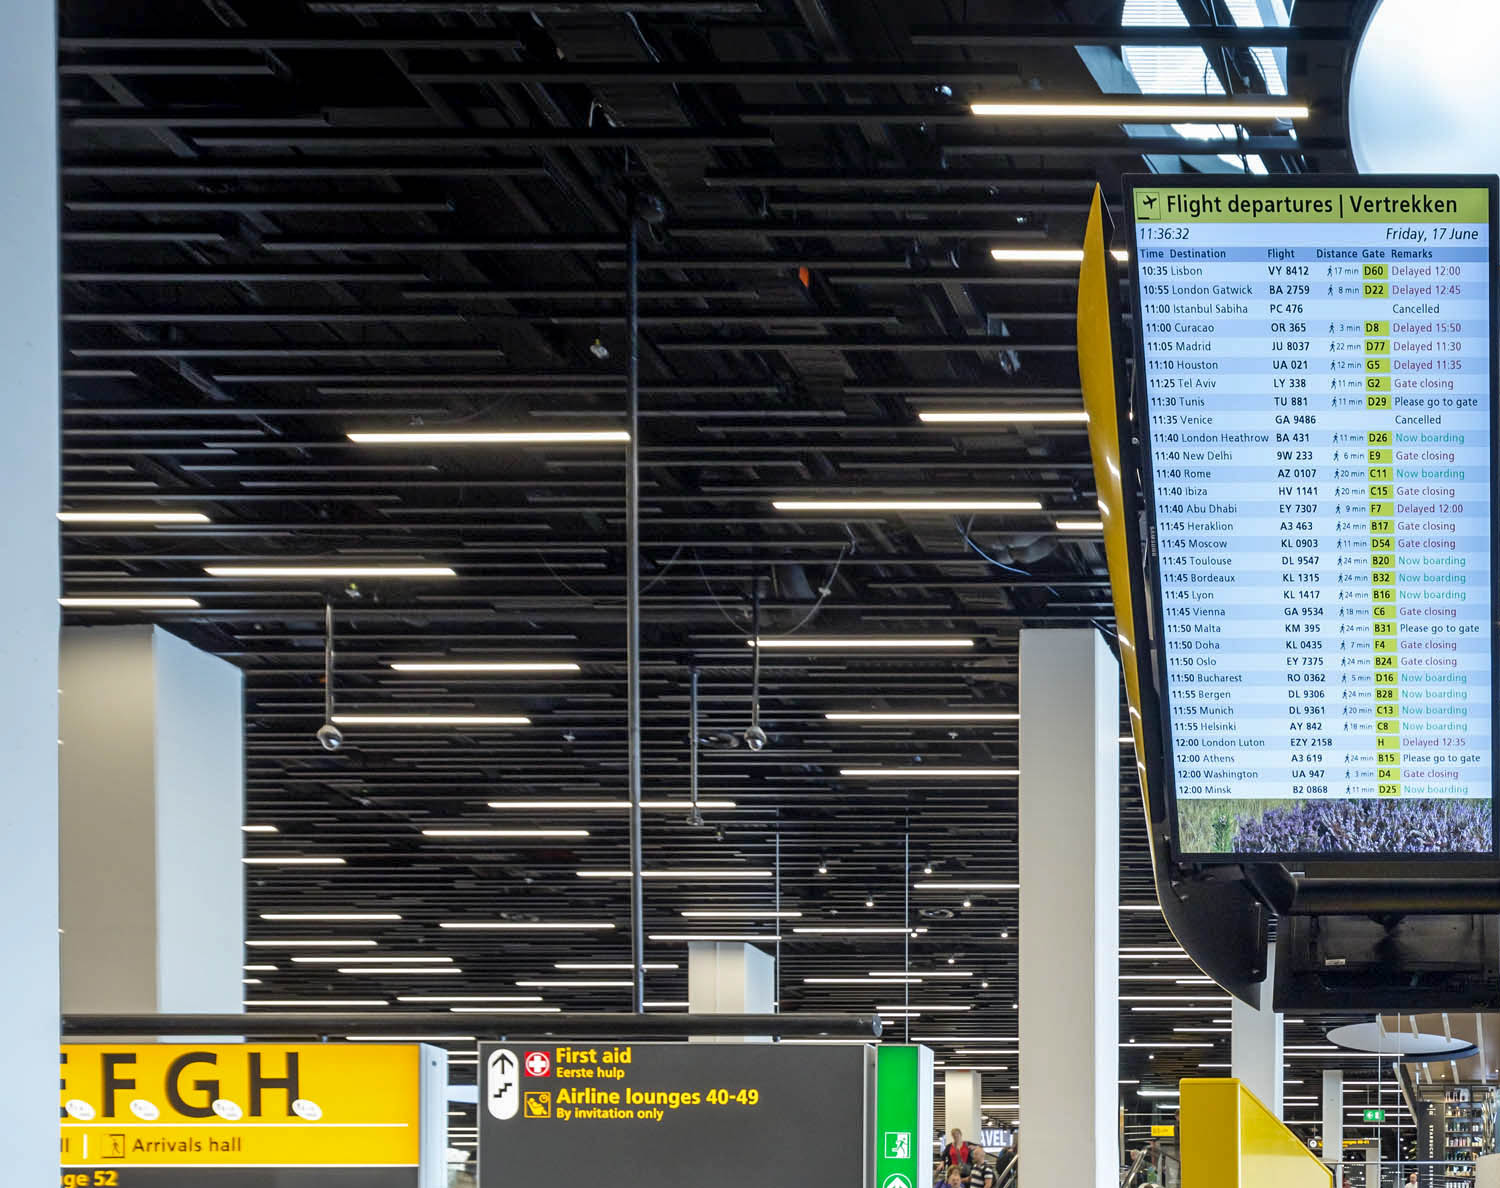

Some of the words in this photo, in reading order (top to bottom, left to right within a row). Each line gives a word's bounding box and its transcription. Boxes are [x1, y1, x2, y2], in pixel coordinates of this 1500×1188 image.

[1168, 194, 1221, 217] Flight
[1228, 194, 1332, 217] departures
[1350, 195, 1456, 212] Vertrekken
[1141, 228, 1189, 239] 11:36:32
[1387, 228, 1426, 242] Friday,
[1433, 228, 1446, 239] 17
[1449, 228, 1478, 239] June
[1140, 249, 1164, 258] Time
[1170, 249, 1225, 258] Destination
[1268, 248, 1294, 260] Flight
[1317, 249, 1357, 258] Distance
[1362, 249, 1384, 258] Gate
[1392, 249, 1432, 258] Remarks
[1143, 266, 1167, 275] 10:35
[1171, 266, 1202, 275] Lisbon
[1268, 266, 1282, 275] VY
[1286, 266, 1308, 275] 8412
[1365, 266, 1383, 275] D60
[1392, 265, 1431, 278] Delayed
[1436, 266, 1460, 276] 12:00
[1145, 304, 1170, 313] 11:00
[1174, 304, 1212, 313] Istanbul
[1216, 304, 1247, 313] Sabiha
[1270, 304, 1282, 313] PC
[1286, 304, 1303, 313] 476
[1393, 304, 1439, 313] Cancelled
[1180, 786, 1202, 794] 12:00
[1404, 785, 1423, 793] Now
[1426, 784, 1468, 795] boarding
[556, 1047, 597, 1064] First
[602, 1047, 632, 1064] aid
[556, 1066, 594, 1078] Eerste
[597, 1066, 625, 1081] hulp
[100, 1052, 137, 1117] F
[164, 1051, 220, 1119] G
[557, 1088, 620, 1105] Airline
[626, 1088, 701, 1110] lounges
[705, 1089, 759, 1105] 40-49
[556, 1108, 572, 1122] By
[574, 1107, 636, 1119] invitation
[638, 1107, 664, 1122] only
[132, 1137, 203, 1153] Arrivals
[209, 1137, 242, 1153] hall
[93, 1171, 119, 1187] 52
